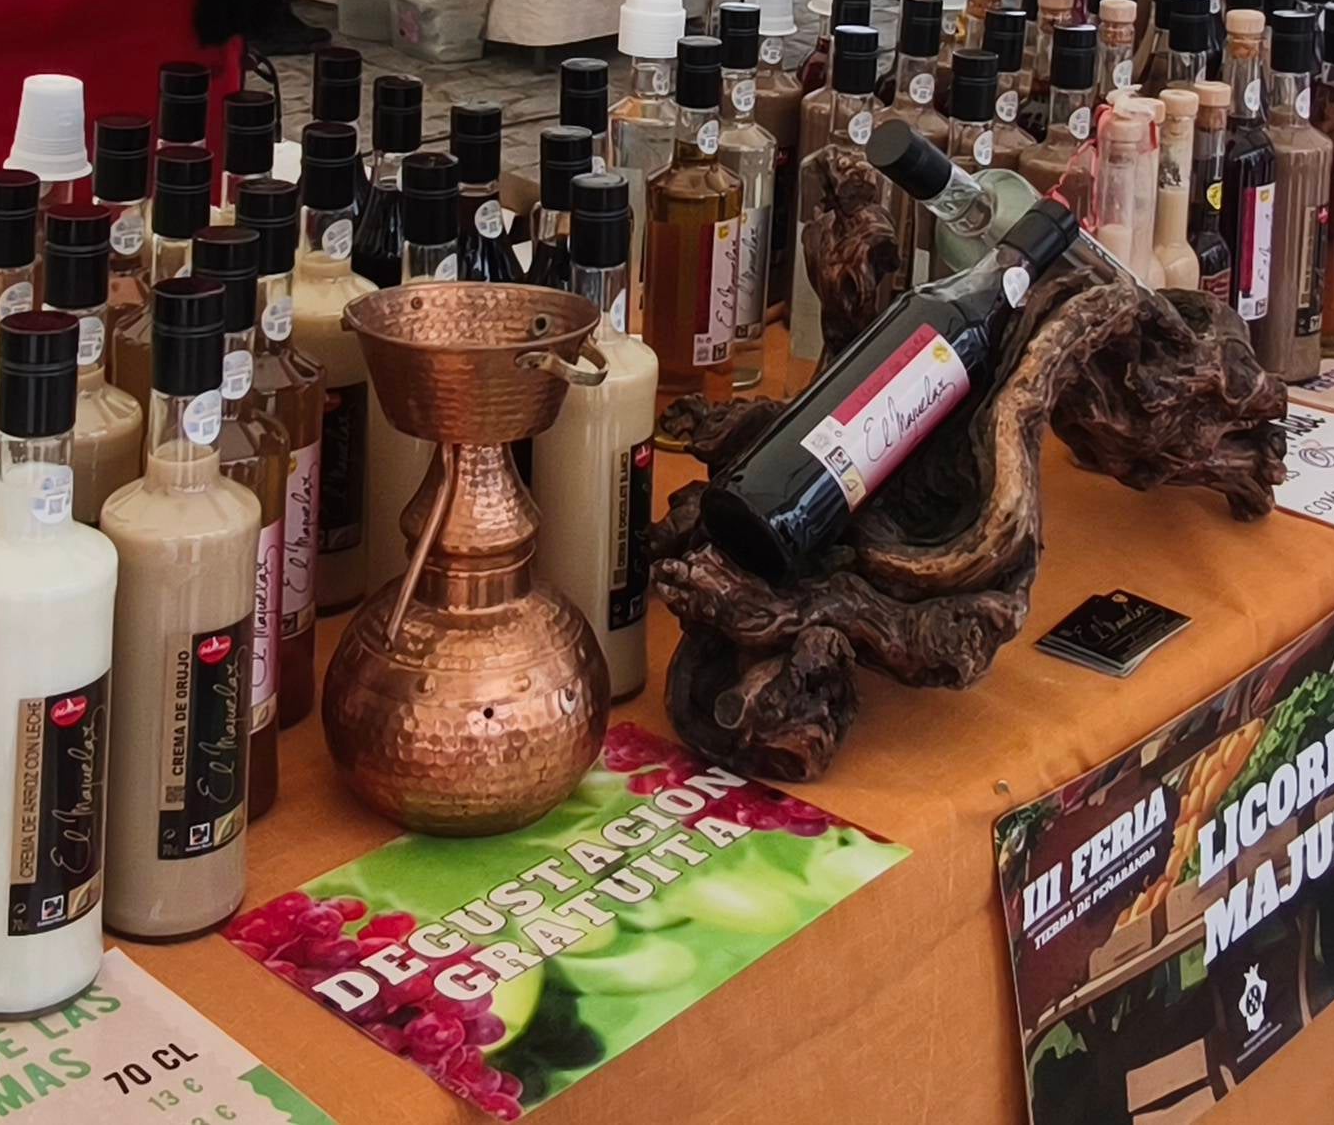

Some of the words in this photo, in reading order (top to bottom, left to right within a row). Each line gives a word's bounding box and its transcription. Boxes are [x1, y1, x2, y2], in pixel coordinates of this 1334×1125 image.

[175, 650, 190, 697] ORUJO
[28, 700, 43, 741] LECHE
[175, 703, 188, 722] DE
[25, 742, 40, 770] CON
[172, 726, 186, 776] CREMA
[23, 771, 40, 812] ARROZ
[197, 761, 235, 803] El
[21, 813, 36, 833] DE
[20, 832, 34, 879] CREMA
[50, 828, 91, 874] El
[1023, 862, 1063, 931] III
[1070, 786, 1166, 893] FERIA
[312, 767, 749, 1013] DEGUSTACIÓN
[434, 816, 753, 1001] GRATUITA
[1034, 910, 1075, 950] TIERRA
[1076, 895, 1091, 917] DE
[103, 1063, 152, 1095] 70
[151, 1042, 199, 1071] CL
[148, 1089, 180, 1111] 13
[182, 1077, 204, 1093] €
